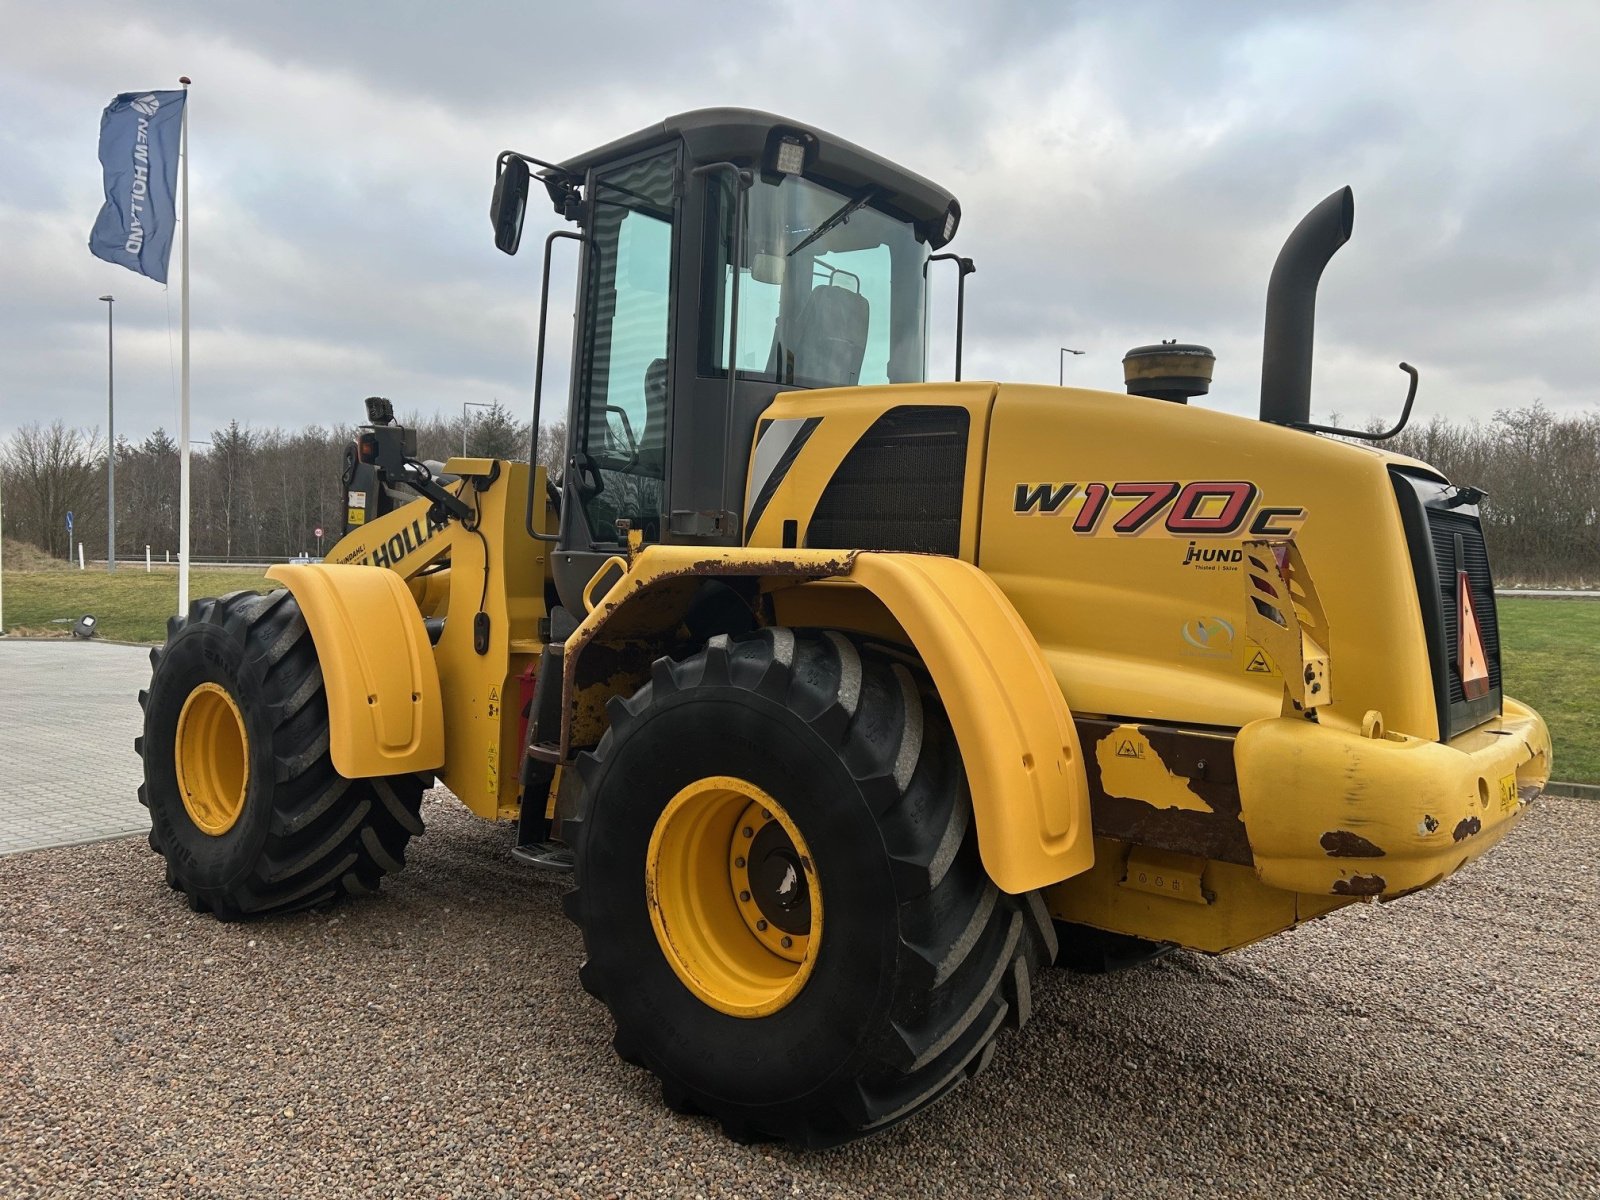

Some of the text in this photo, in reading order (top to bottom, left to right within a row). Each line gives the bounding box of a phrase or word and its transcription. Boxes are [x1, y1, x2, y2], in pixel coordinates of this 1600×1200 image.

[125, 117, 149, 255] NEW HOLLAND
[372, 511, 450, 569] HOLLA
